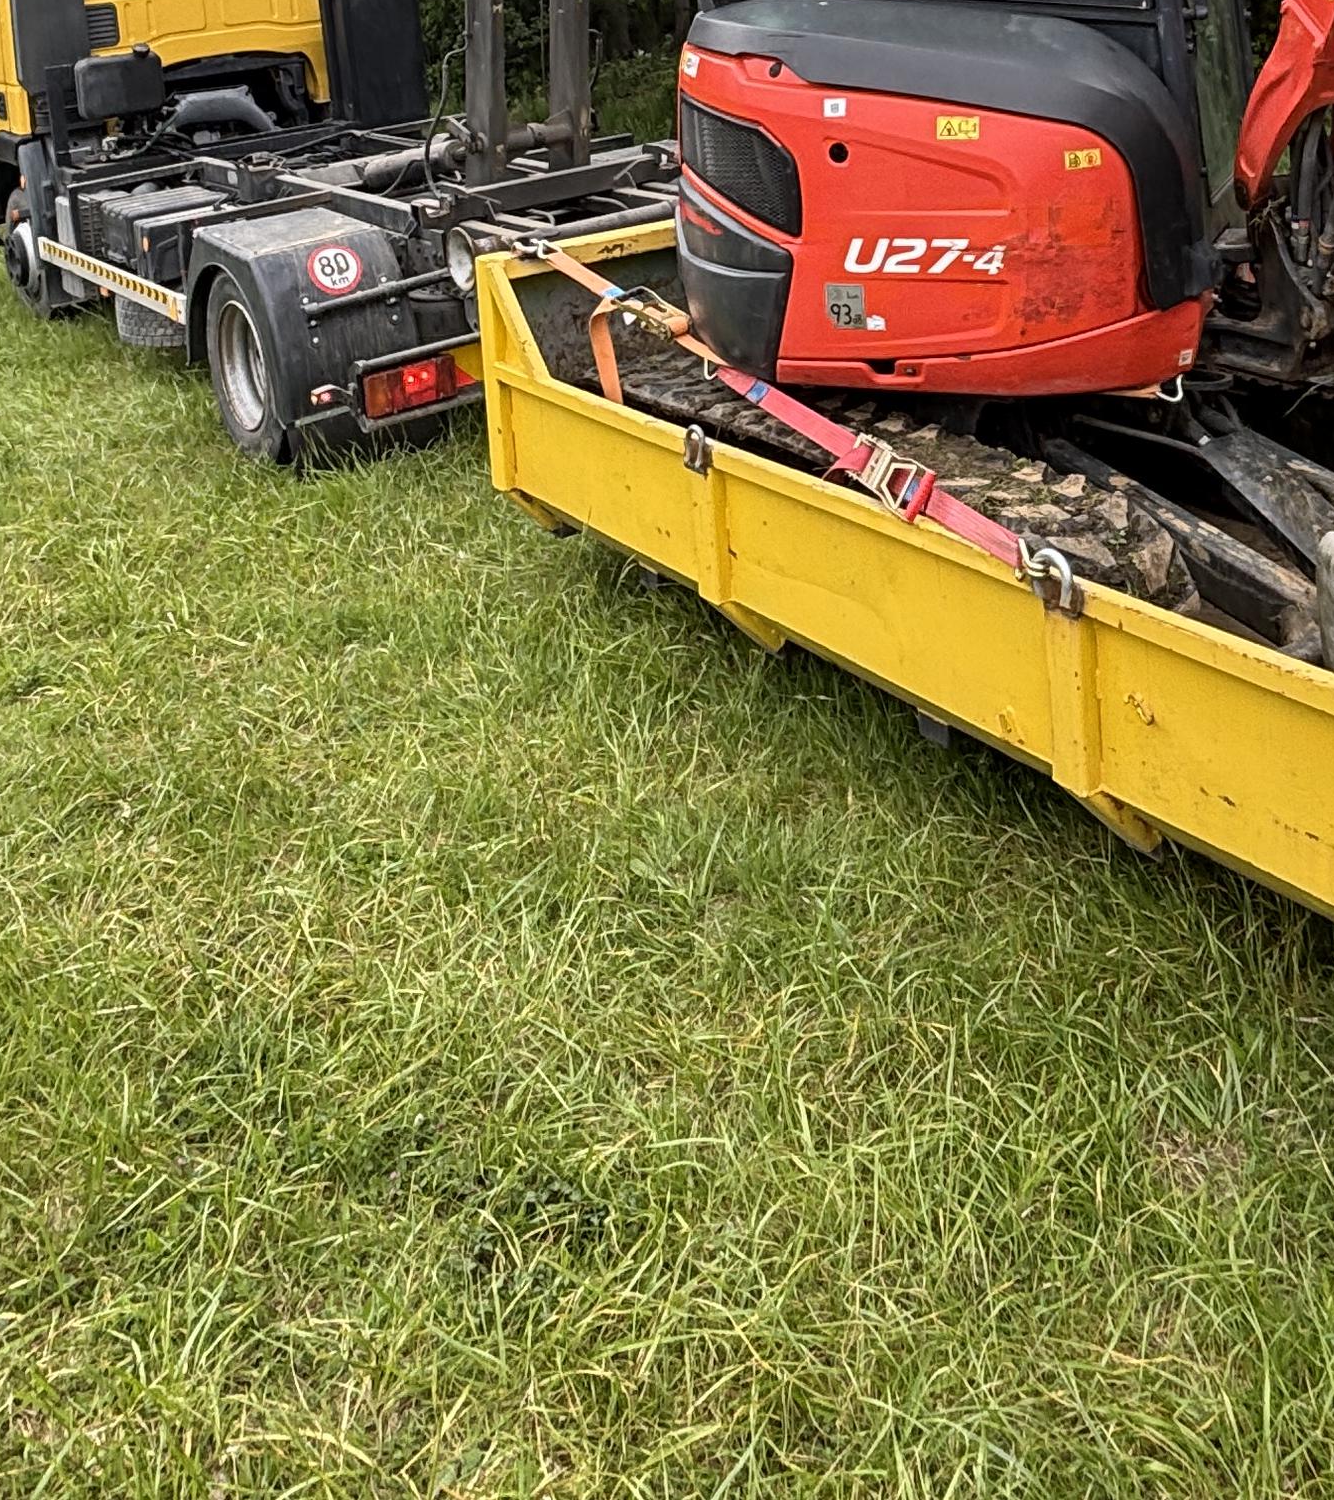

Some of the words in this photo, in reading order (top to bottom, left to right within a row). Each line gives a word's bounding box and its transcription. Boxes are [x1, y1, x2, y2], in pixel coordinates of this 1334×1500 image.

[318, 252, 350, 276] 80
[843, 237, 1008, 275] U27-4
[330, 276, 350, 286] km
[830, 303, 852, 325] 93
